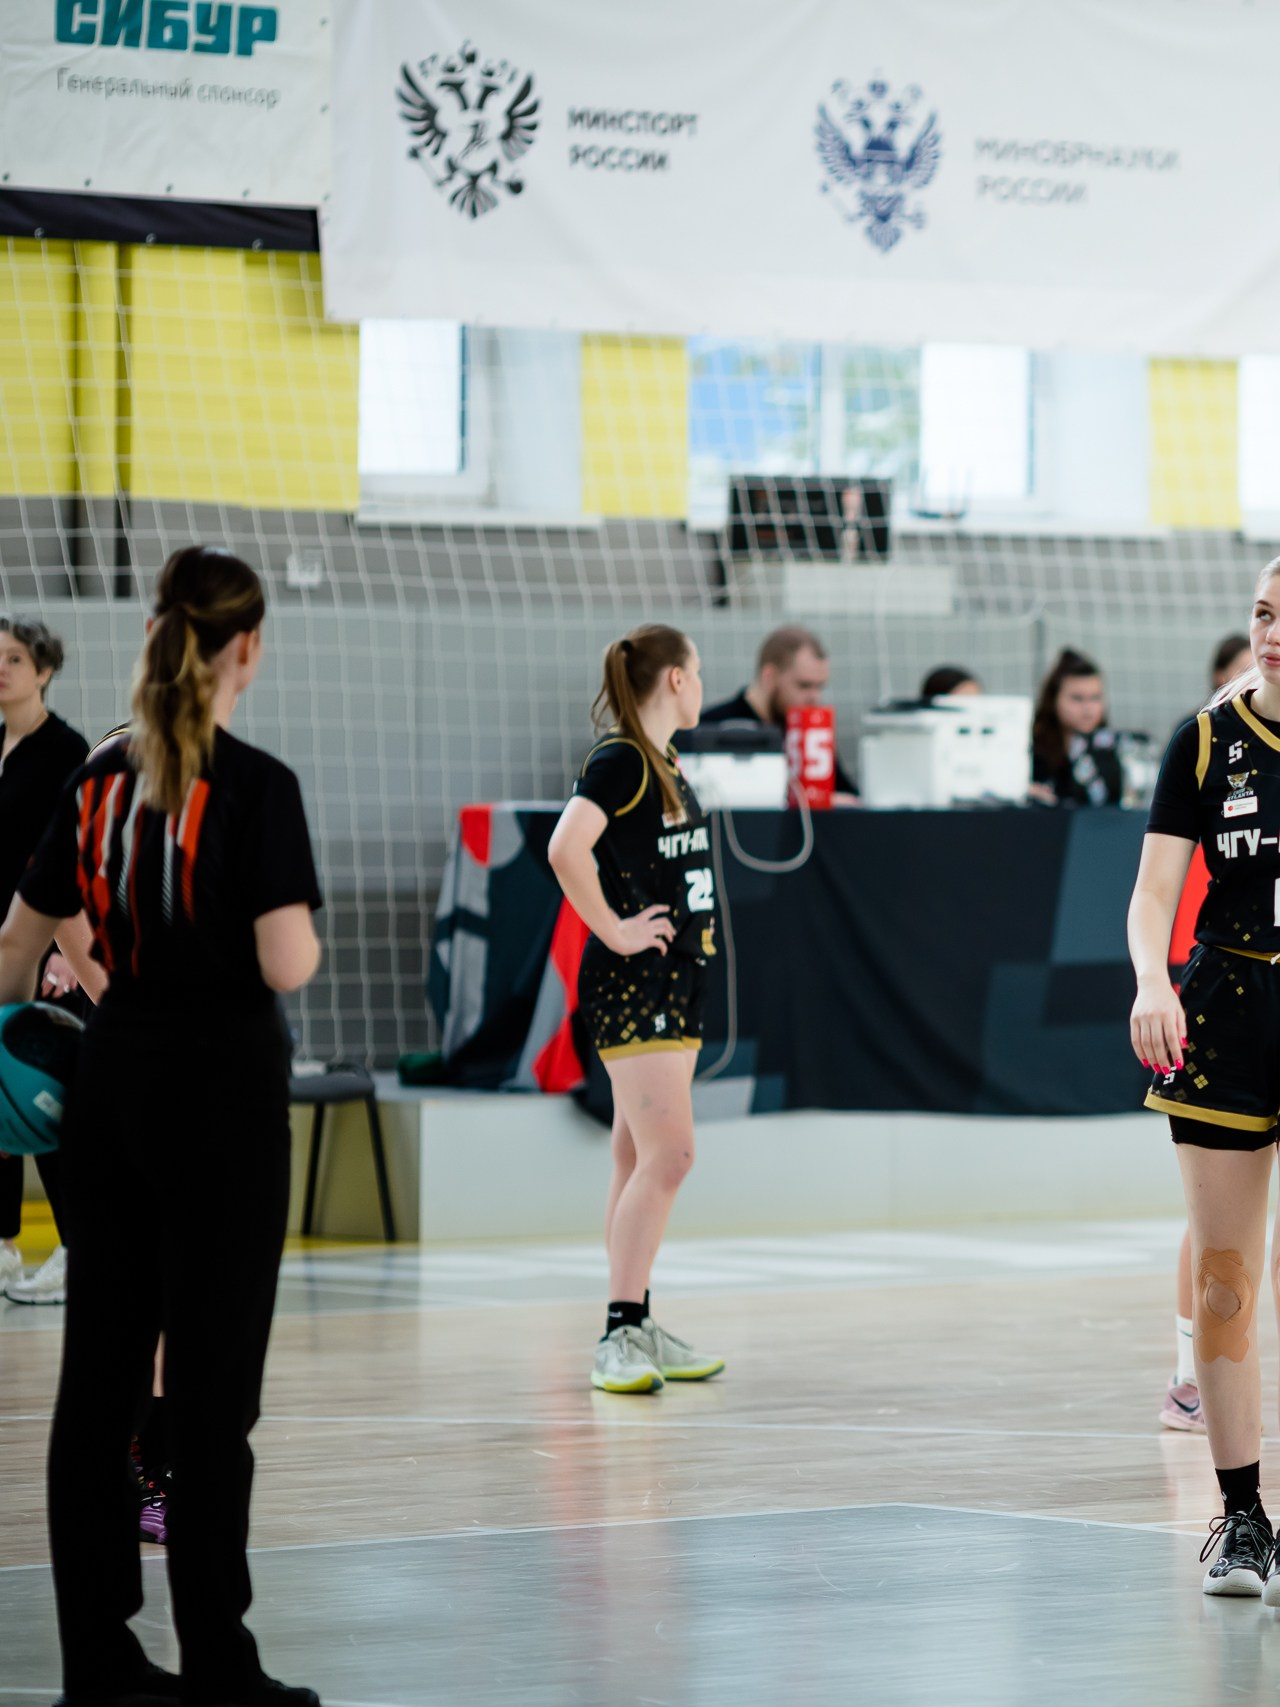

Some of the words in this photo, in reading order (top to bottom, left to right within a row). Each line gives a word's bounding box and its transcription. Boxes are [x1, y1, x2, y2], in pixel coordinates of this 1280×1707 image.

[55, 0, 278, 56] СИБУР
[57, 67, 192, 98] Генеральный
[196, 83, 282, 110] спонсор
[568, 107, 698, 137] МИНСПОРТ
[569, 144, 669, 170] РОССИИ
[976, 175, 1088, 204] РОССИИ
[804, 728, 834, 780] 5
